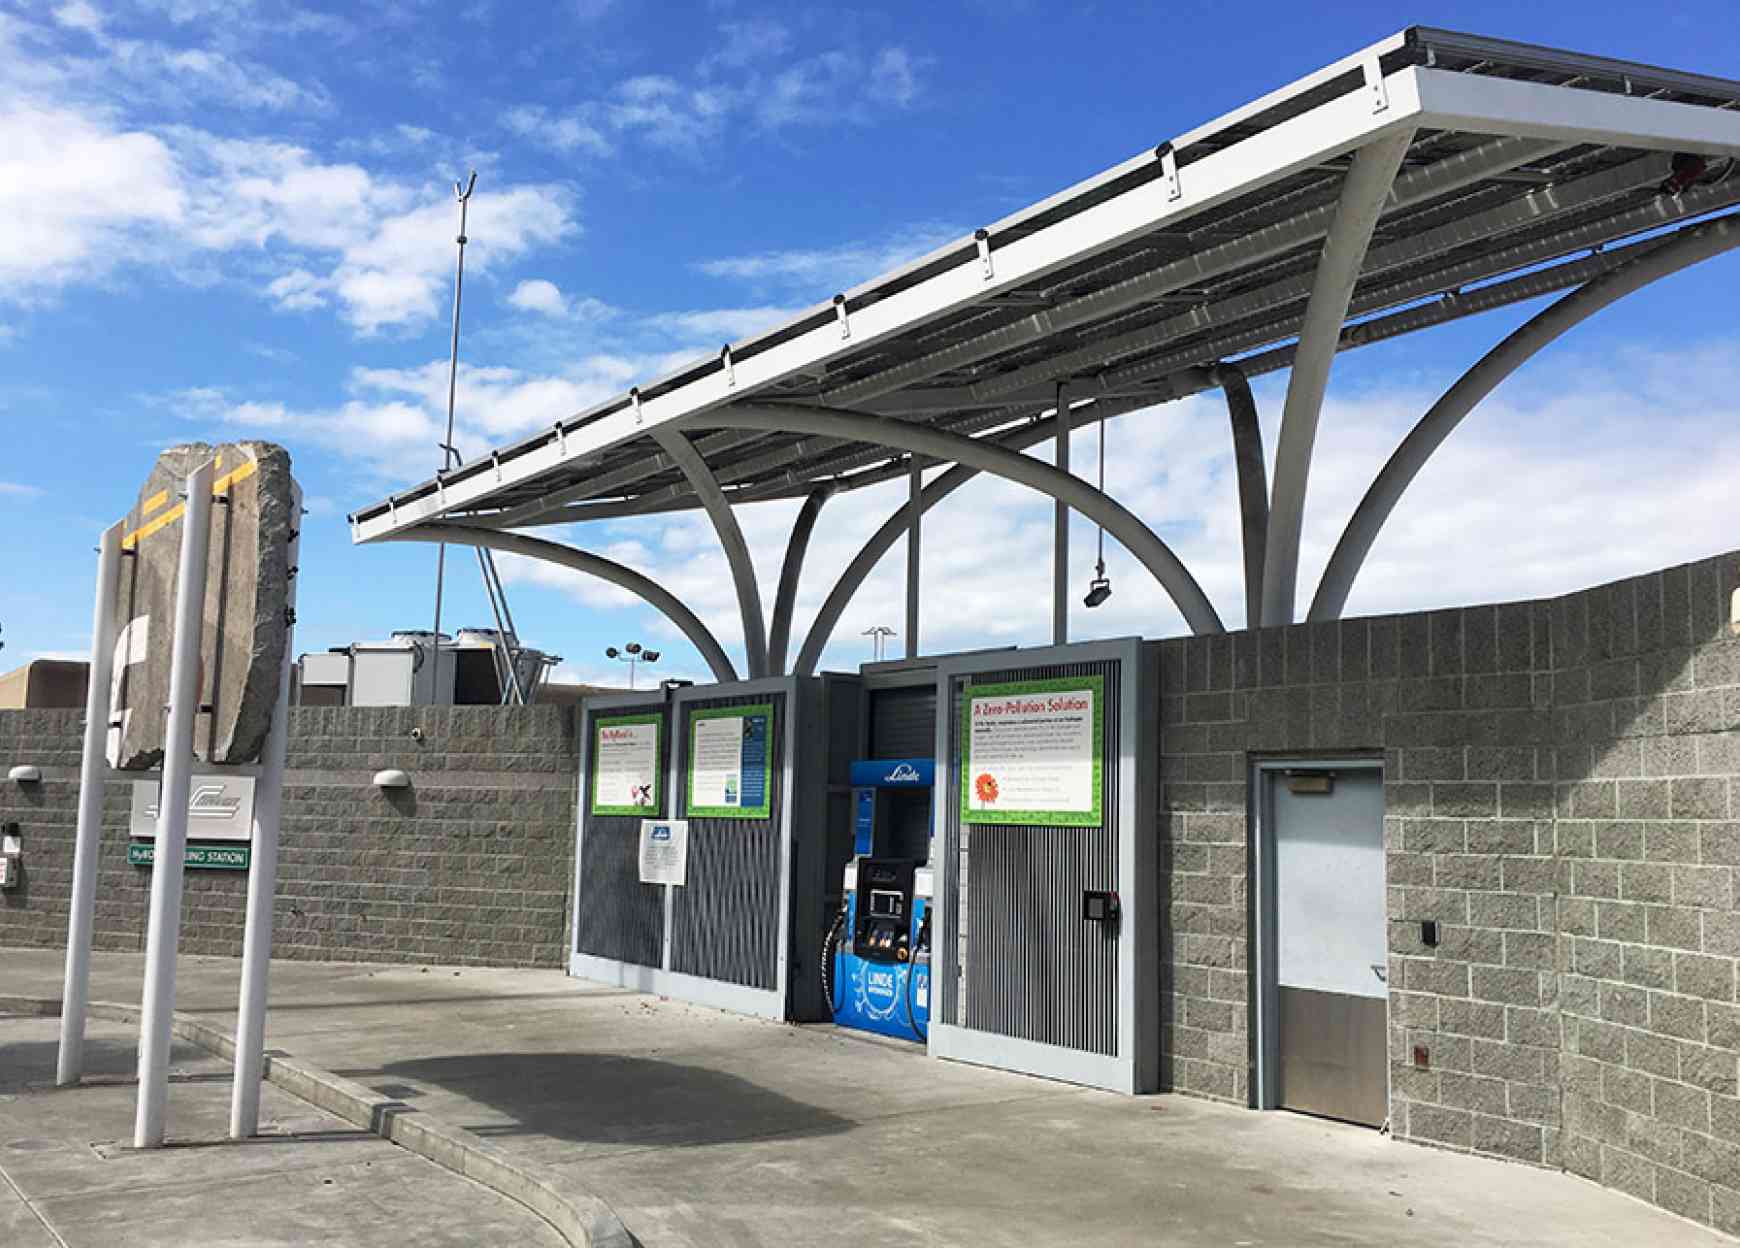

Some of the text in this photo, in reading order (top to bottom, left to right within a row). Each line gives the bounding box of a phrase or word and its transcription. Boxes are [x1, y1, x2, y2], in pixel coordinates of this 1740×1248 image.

[974, 697, 1089, 716] A Zero-Pollution Solution
[884, 763, 919, 782] Linde
[207, 851, 244, 864] STATION
[868, 971, 893, 988] LINDE
